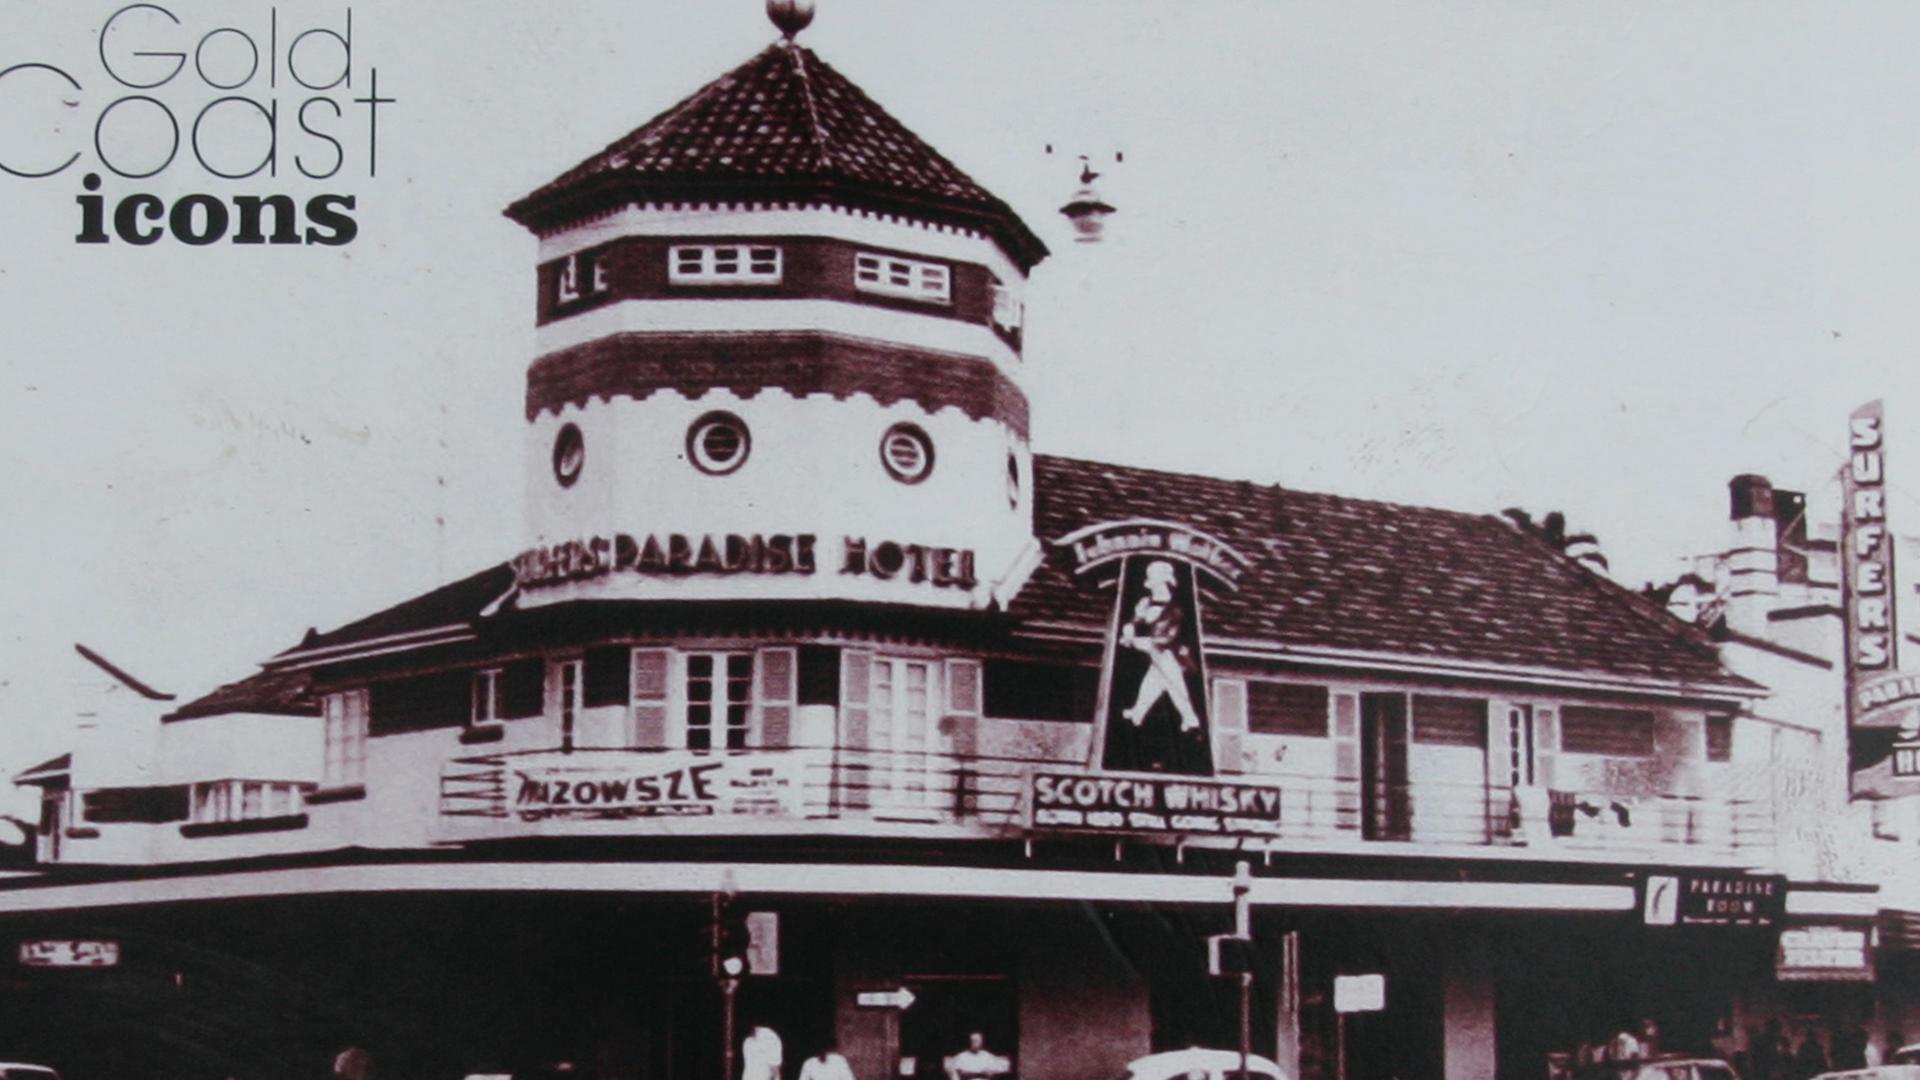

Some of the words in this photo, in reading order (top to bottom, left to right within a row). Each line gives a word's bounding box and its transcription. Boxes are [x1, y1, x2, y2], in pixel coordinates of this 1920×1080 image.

[100, 4, 351, 89] Gold
[0, 63, 396, 178] Coast
[76, 173, 358, 245] icons
[614, 533, 817, 575] PARADISE
[840, 535, 977, 590] HOTEL
[1849, 417, 1889, 670] SURFERS
[1034, 776, 1154, 808] SCOTCH
[1164, 784, 1279, 814] WHISKY
